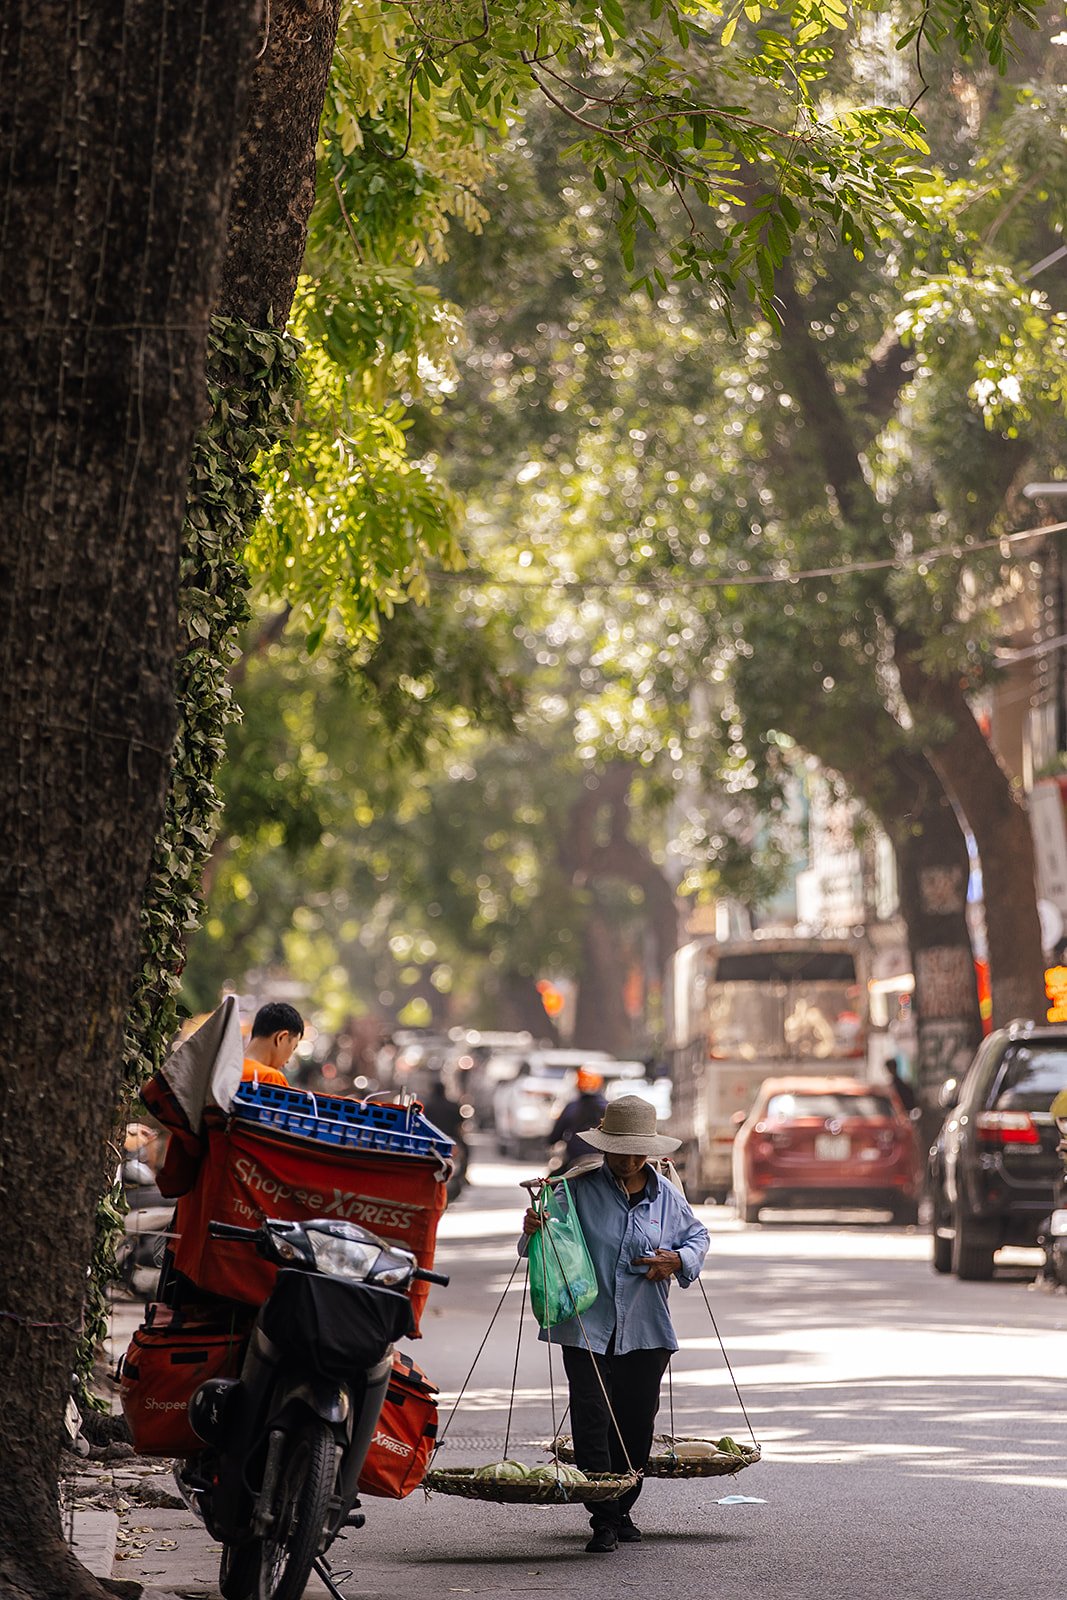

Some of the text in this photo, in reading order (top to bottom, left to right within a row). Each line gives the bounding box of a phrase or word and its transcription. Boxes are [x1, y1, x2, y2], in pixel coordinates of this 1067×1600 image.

[234, 1158, 416, 1229] Shopee XPRESS
[144, 1397, 188, 1413] Shopee
[370, 1430, 412, 1458] XPRESS
